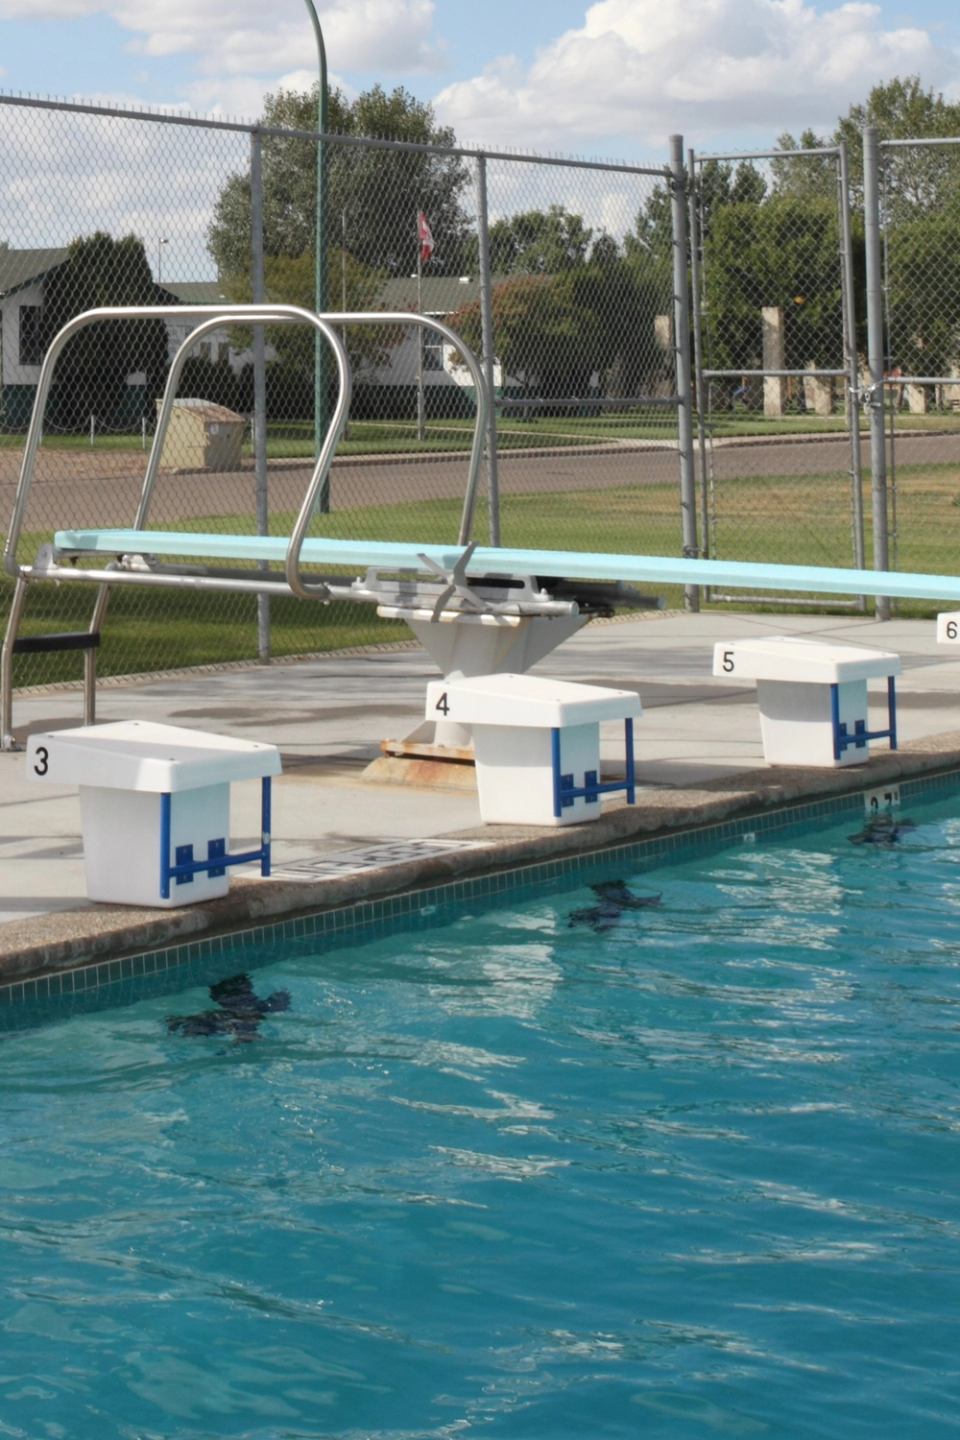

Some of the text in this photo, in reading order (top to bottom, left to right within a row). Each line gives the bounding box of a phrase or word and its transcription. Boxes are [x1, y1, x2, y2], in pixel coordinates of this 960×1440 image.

[946, 621, 958, 639] 6
[722, 651, 734, 672] 5
[435, 692, 450, 716] 4
[34, 747, 48, 776] 3
